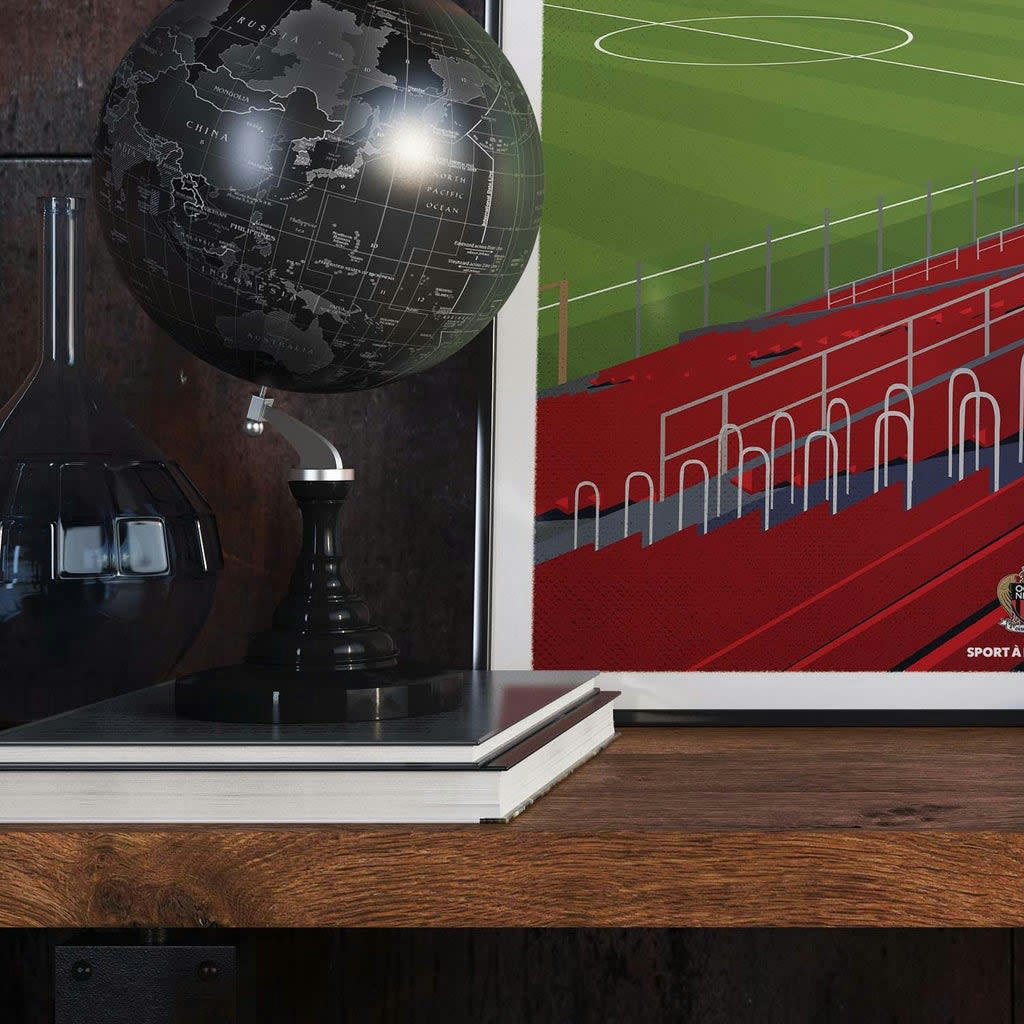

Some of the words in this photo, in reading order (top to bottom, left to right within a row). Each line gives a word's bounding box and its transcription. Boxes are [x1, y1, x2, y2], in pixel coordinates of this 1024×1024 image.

[236, 16, 299, 44] RUSSIA
[213, 85, 250, 103] MONGOLIA
[186, 120, 228, 142] CHINA
[426, 186, 465, 200] PACIFIC
[426, 202, 459, 214] OCEAN
[967, 647, 1010, 658] SPORT
[1012, 644, 1021, 658] À
